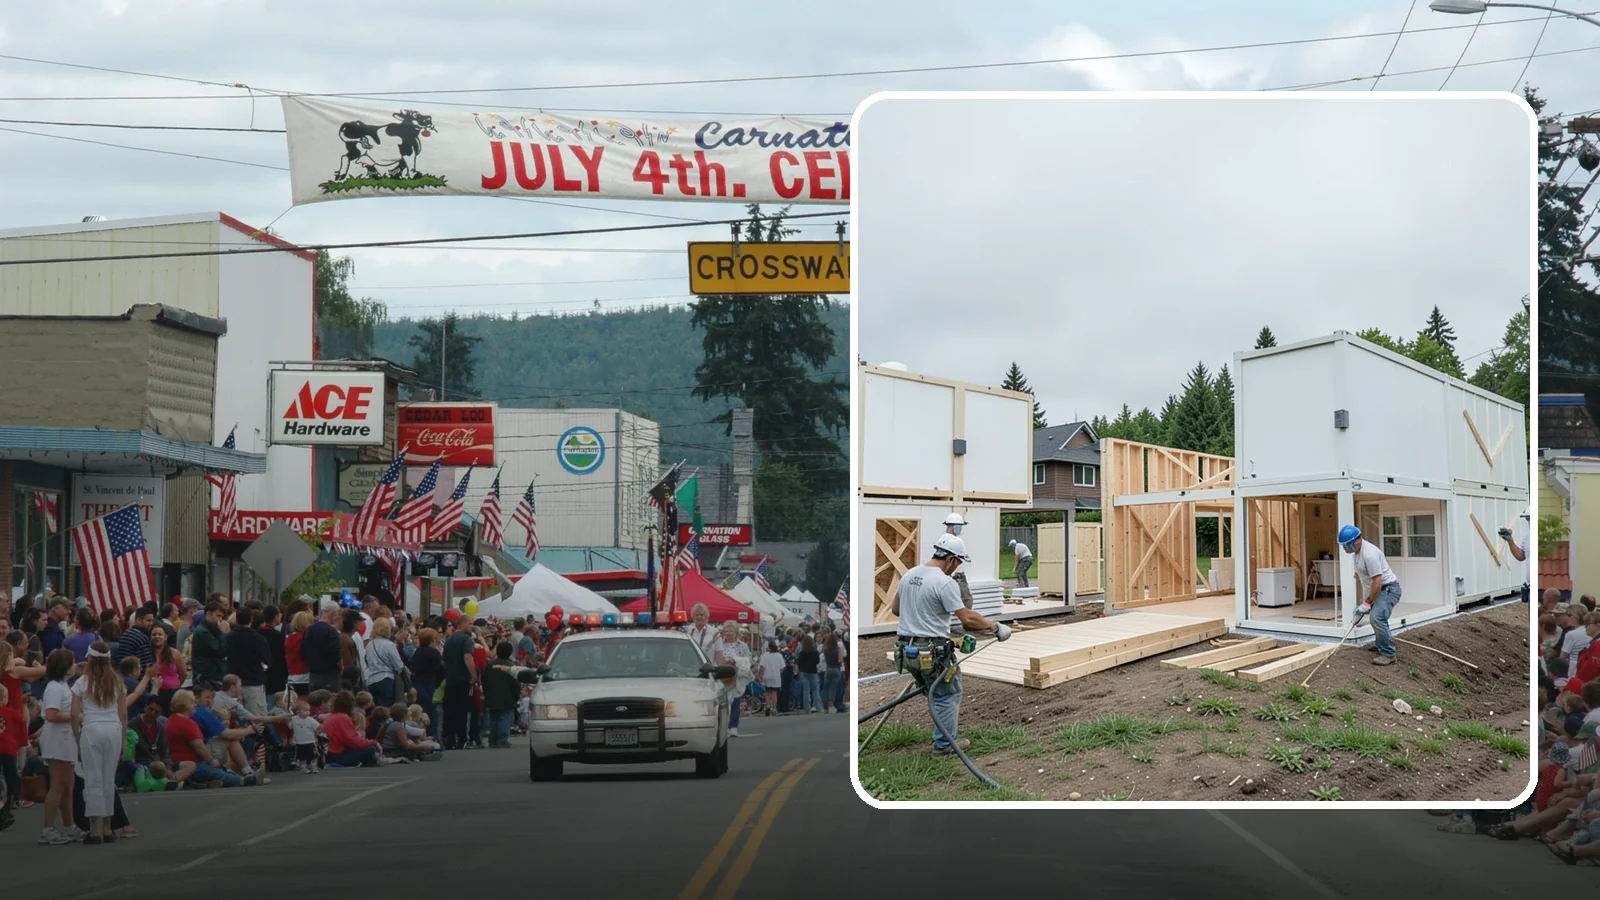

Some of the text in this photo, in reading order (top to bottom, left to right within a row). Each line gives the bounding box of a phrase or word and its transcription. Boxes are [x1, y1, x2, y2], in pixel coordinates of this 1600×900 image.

[481, 141, 605, 192] JULY
[632, 150, 746, 198] 4th.
[697, 254, 850, 280] CROSSWA
[282, 380, 374, 420] ACE
[405, 409, 452, 421] CEDAR
[283, 421, 370, 436] Hardware
[416, 428, 476, 447] Coca-Cola
[96, 485, 124, 494] Vincent
[126, 486, 135, 494] de
[137, 486, 155, 495] Paul
[212, 515, 330, 536] HARDARE
[688, 526, 741, 535] CRNATION
[699, 535, 730, 543] GLASS
